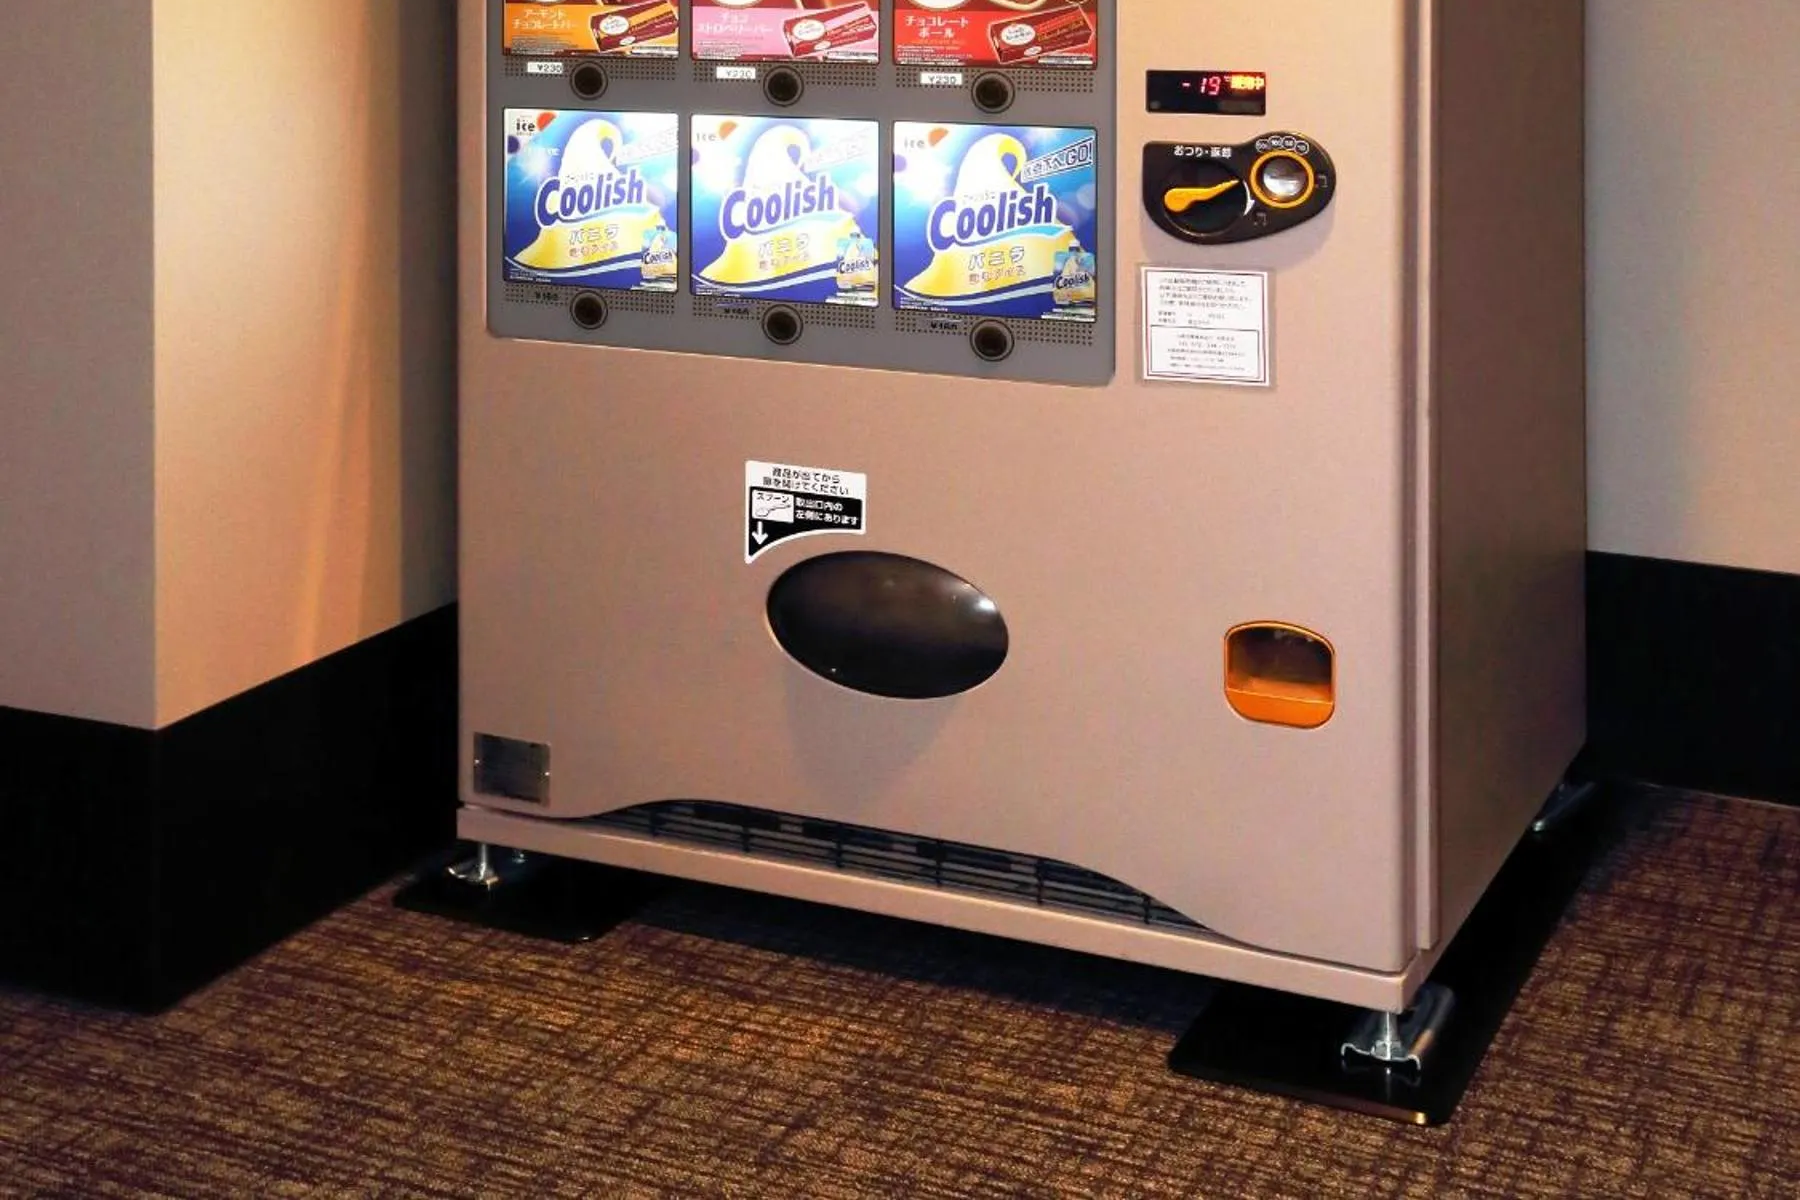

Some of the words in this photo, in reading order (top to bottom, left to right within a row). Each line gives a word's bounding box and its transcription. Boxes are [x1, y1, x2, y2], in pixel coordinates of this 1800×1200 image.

[906, 16, 969, 27] チョコレート
[928, 75, 956, 85] ¥230
[516, 118, 536, 132] ice
[904, 136, 925, 149] ice
[537, 169, 644, 227] Coolish
[722, 175, 834, 240] Coolish
[930, 185, 1053, 250] Coolish
[569, 224, 620, 244] バニラ
[968, 246, 1025, 270] バニラ
[1056, 274, 1089, 289] Coolish
